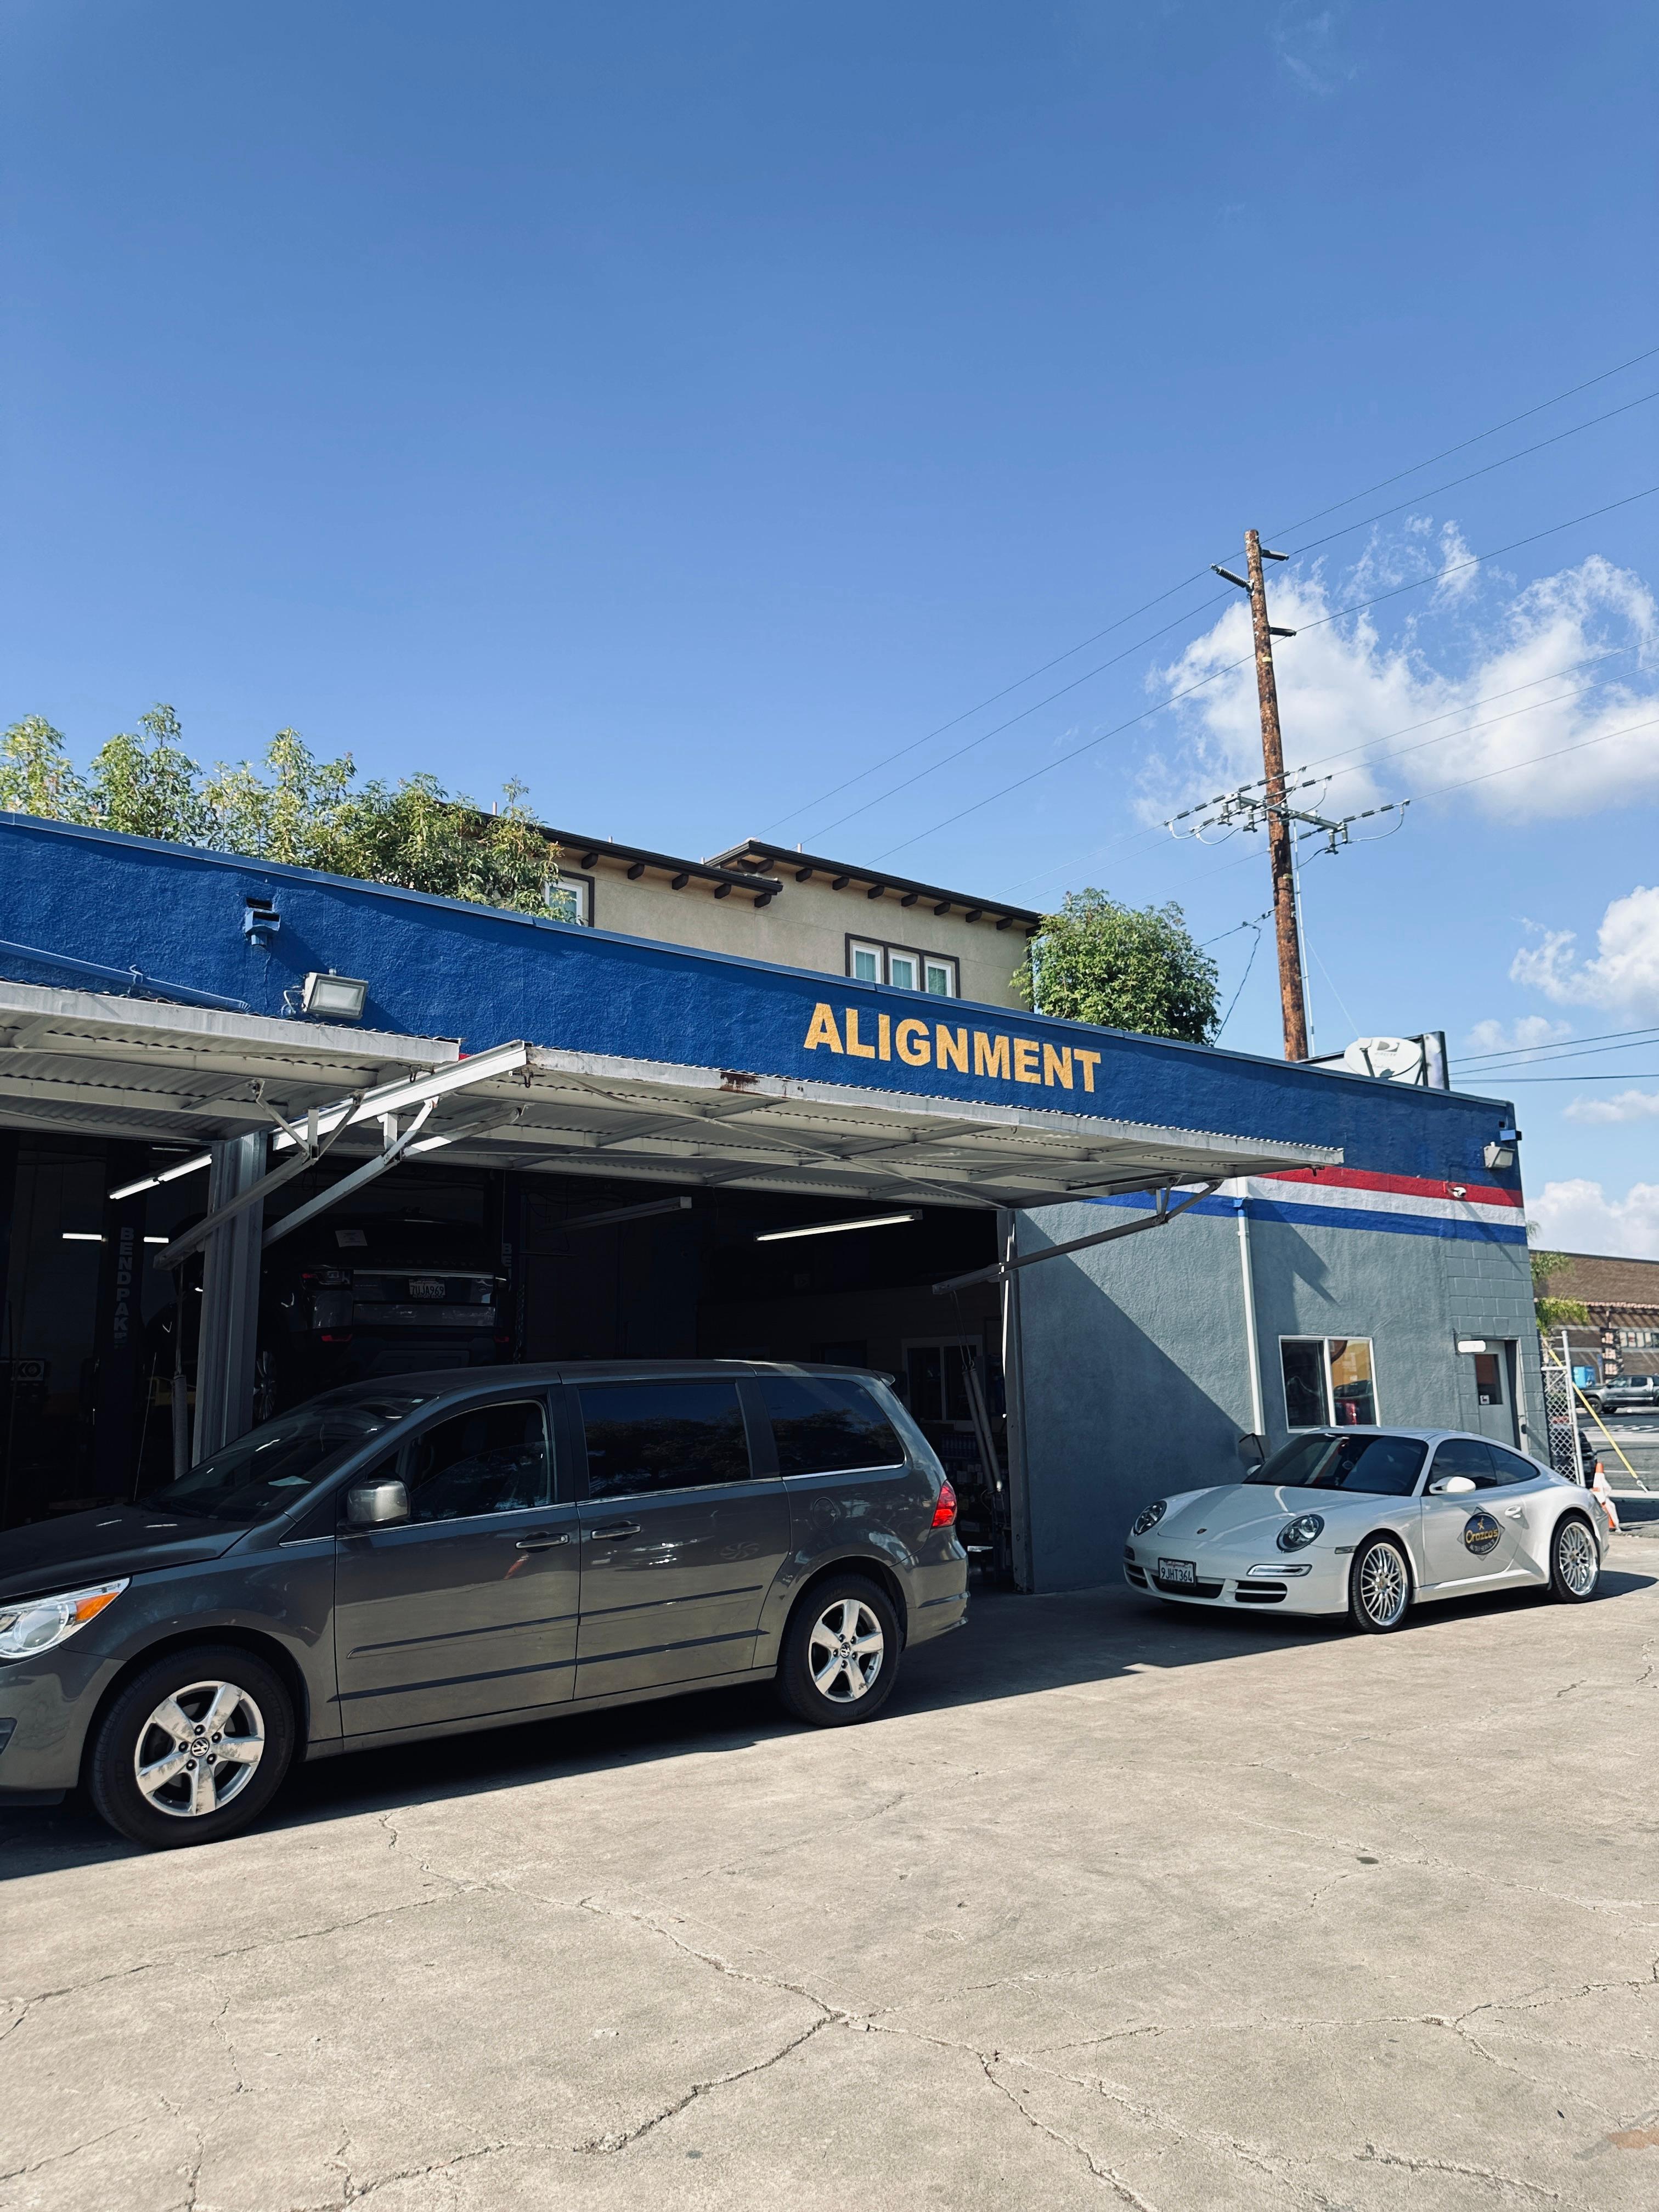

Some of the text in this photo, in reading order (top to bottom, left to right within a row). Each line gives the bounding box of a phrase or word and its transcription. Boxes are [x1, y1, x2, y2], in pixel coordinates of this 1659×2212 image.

[804, 1002, 1102, 1093] ALIGNMENT
[114, 1227, 134, 1330] BENDPAK
[410, 1285, 444, 1295] 7UJA969
[1161, 1567, 1193, 1582] 9JHT364
